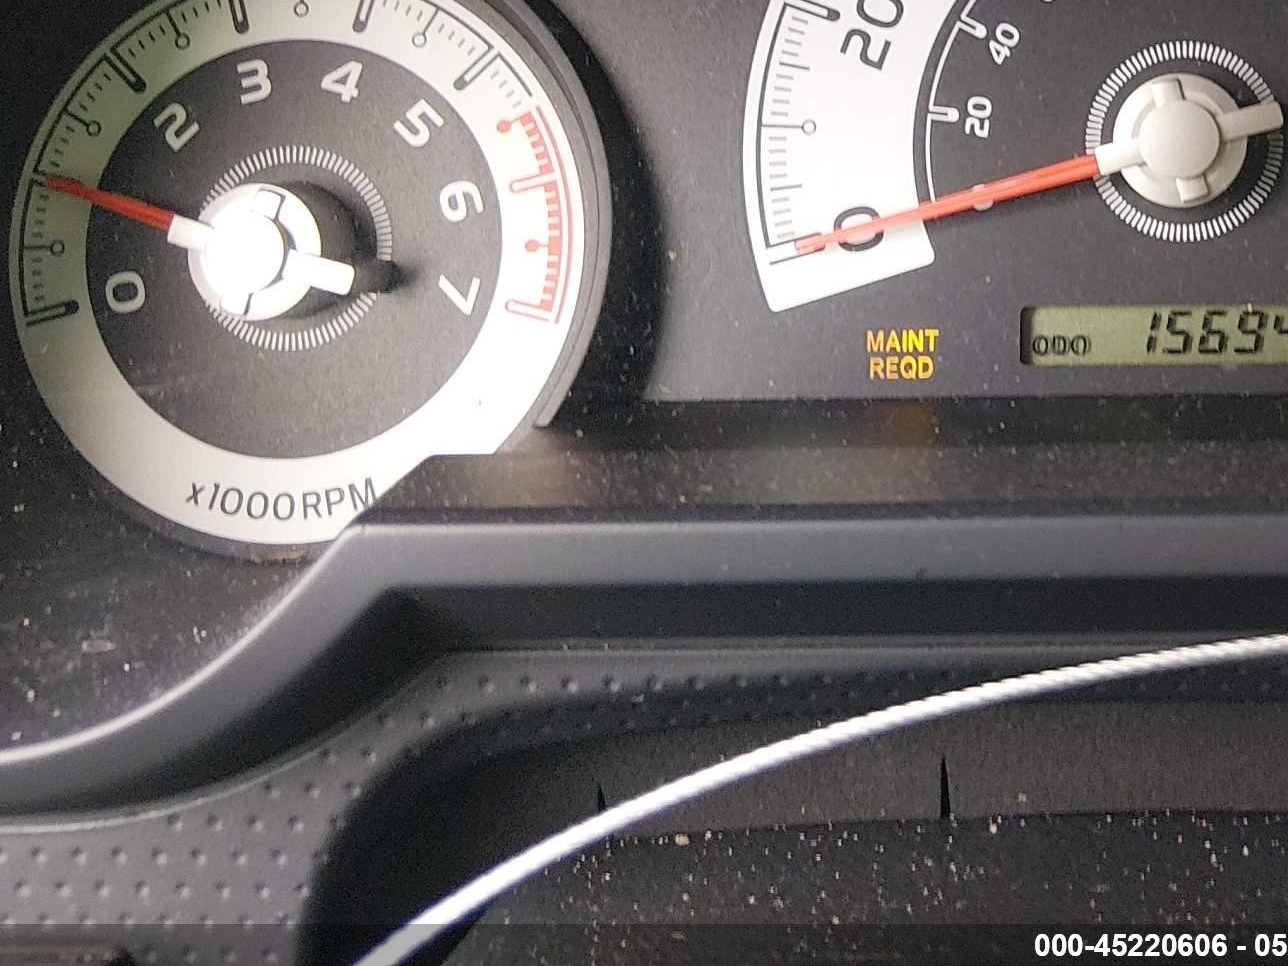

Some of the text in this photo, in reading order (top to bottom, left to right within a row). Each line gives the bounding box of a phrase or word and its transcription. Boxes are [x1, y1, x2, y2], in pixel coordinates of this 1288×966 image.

[988, 22, 1021, 65] 40
[236, 58, 272, 105] 3
[321, 60, 365, 103] 4
[154, 102, 200, 152] 2
[393, 99, 444, 148] 5
[965, 95, 993, 138] 20
[439, 179, 484, 224] 6
[105, 270, 146, 315] 0
[438, 274, 481, 316] 7
[866, 329, 939, 353] MAINT
[869, 355, 934, 379] REQD
